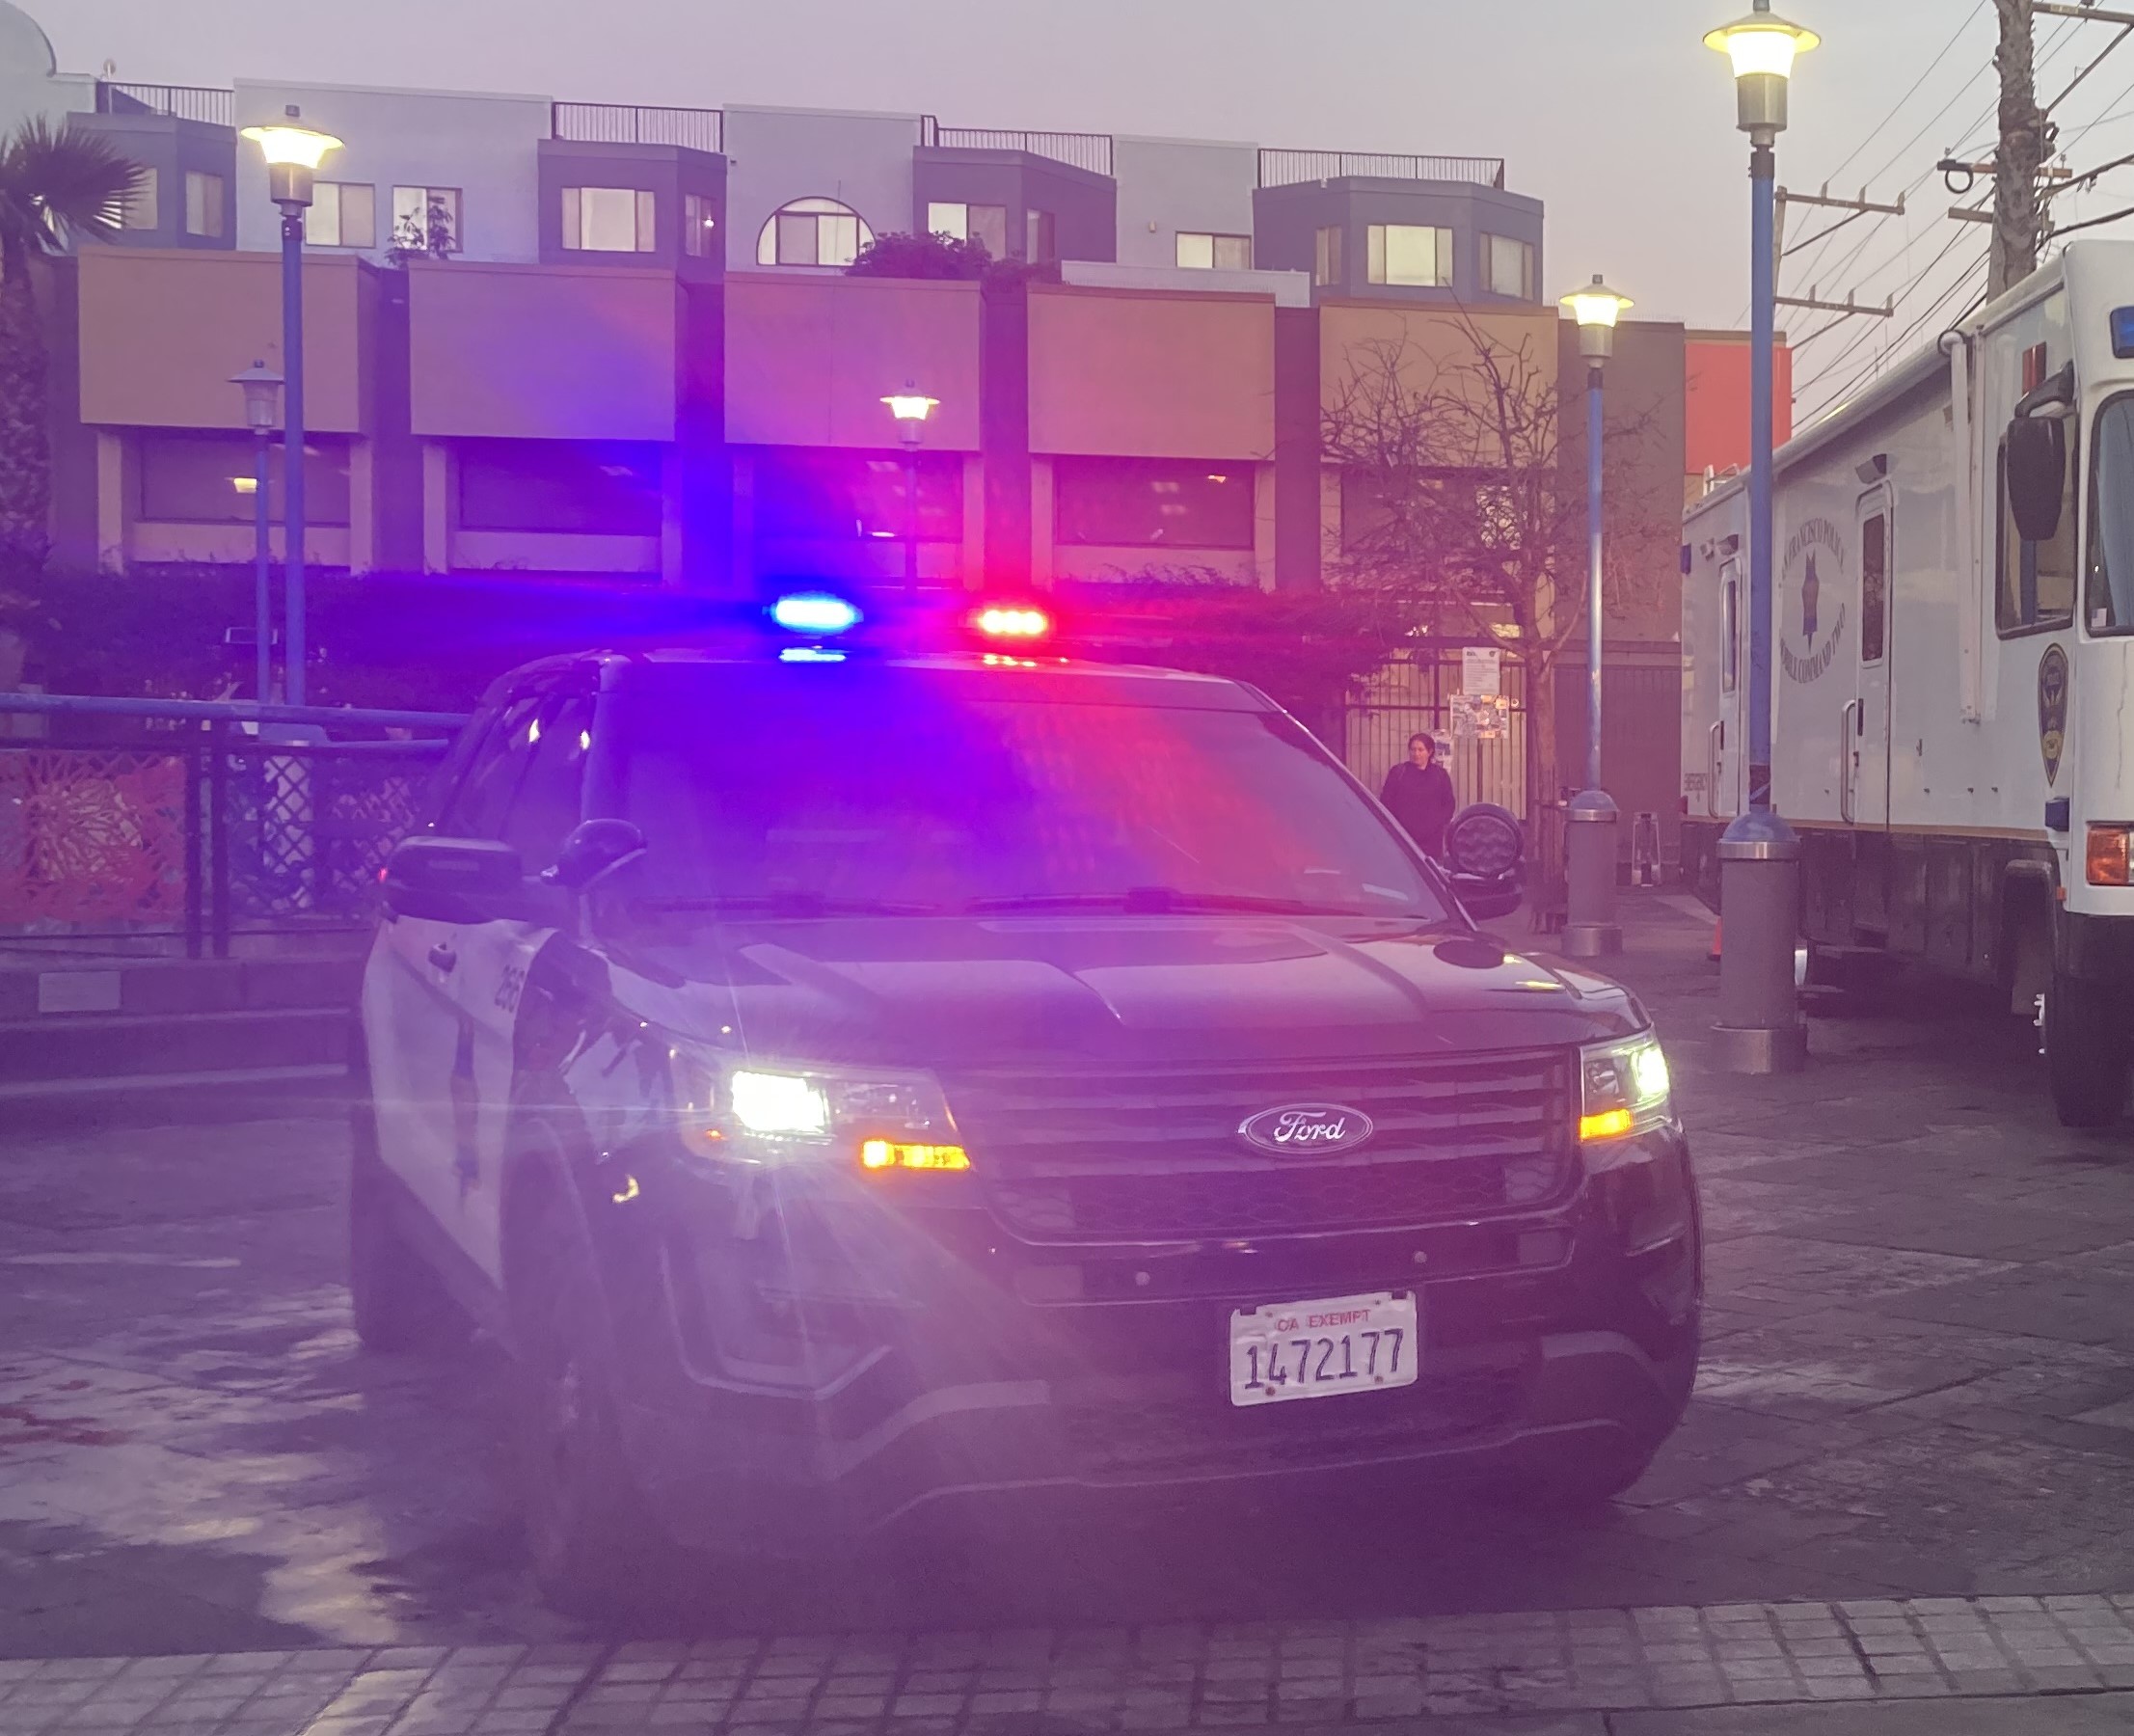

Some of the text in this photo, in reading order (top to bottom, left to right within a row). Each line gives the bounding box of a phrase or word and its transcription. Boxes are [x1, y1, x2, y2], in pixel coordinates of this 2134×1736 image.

[1273, 1110, 1346, 1143] Ford
[1277, 1309, 1372, 1332] CA EXEMPT
[1244, 1328, 1404, 1390] 1472177
